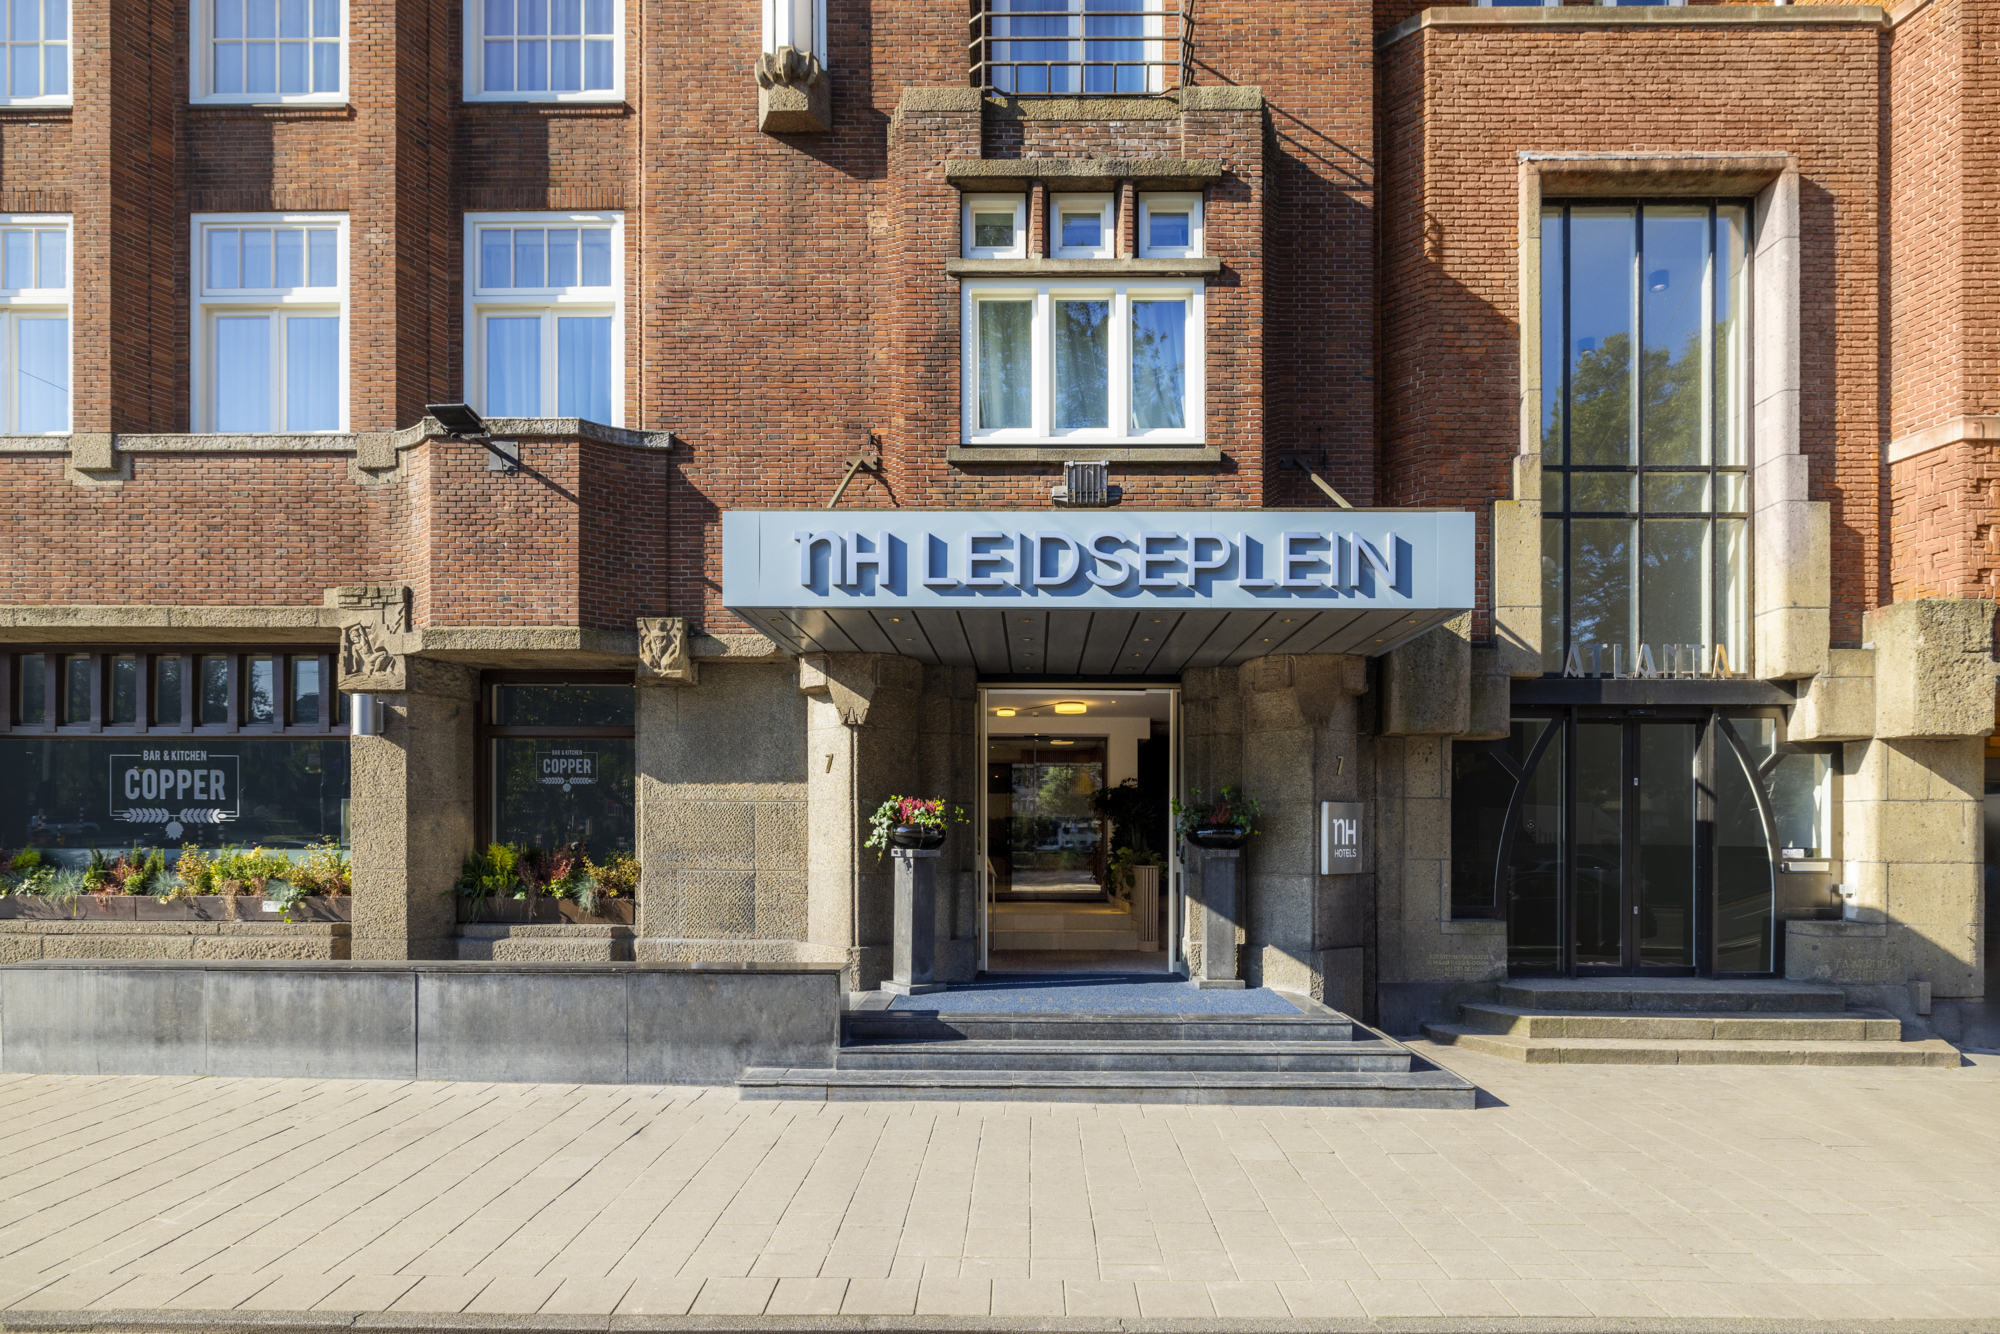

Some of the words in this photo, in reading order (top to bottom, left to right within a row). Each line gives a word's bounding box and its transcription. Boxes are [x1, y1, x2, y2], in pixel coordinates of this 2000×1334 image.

[922, 530, 1397, 588] LEIDSEPLEIN
[1563, 643, 1733, 679] ATLANTA
[143, 750, 161, 761] BAR
[163, 750, 170, 761] &
[171, 750, 207, 761] KITCHEN
[825, 753, 834, 773] 7
[543, 758, 592, 774] COPPER
[1336, 756, 1345, 775] 7
[125, 768, 226, 800] COPPER
[1334, 848, 1356, 858] HOTELS
